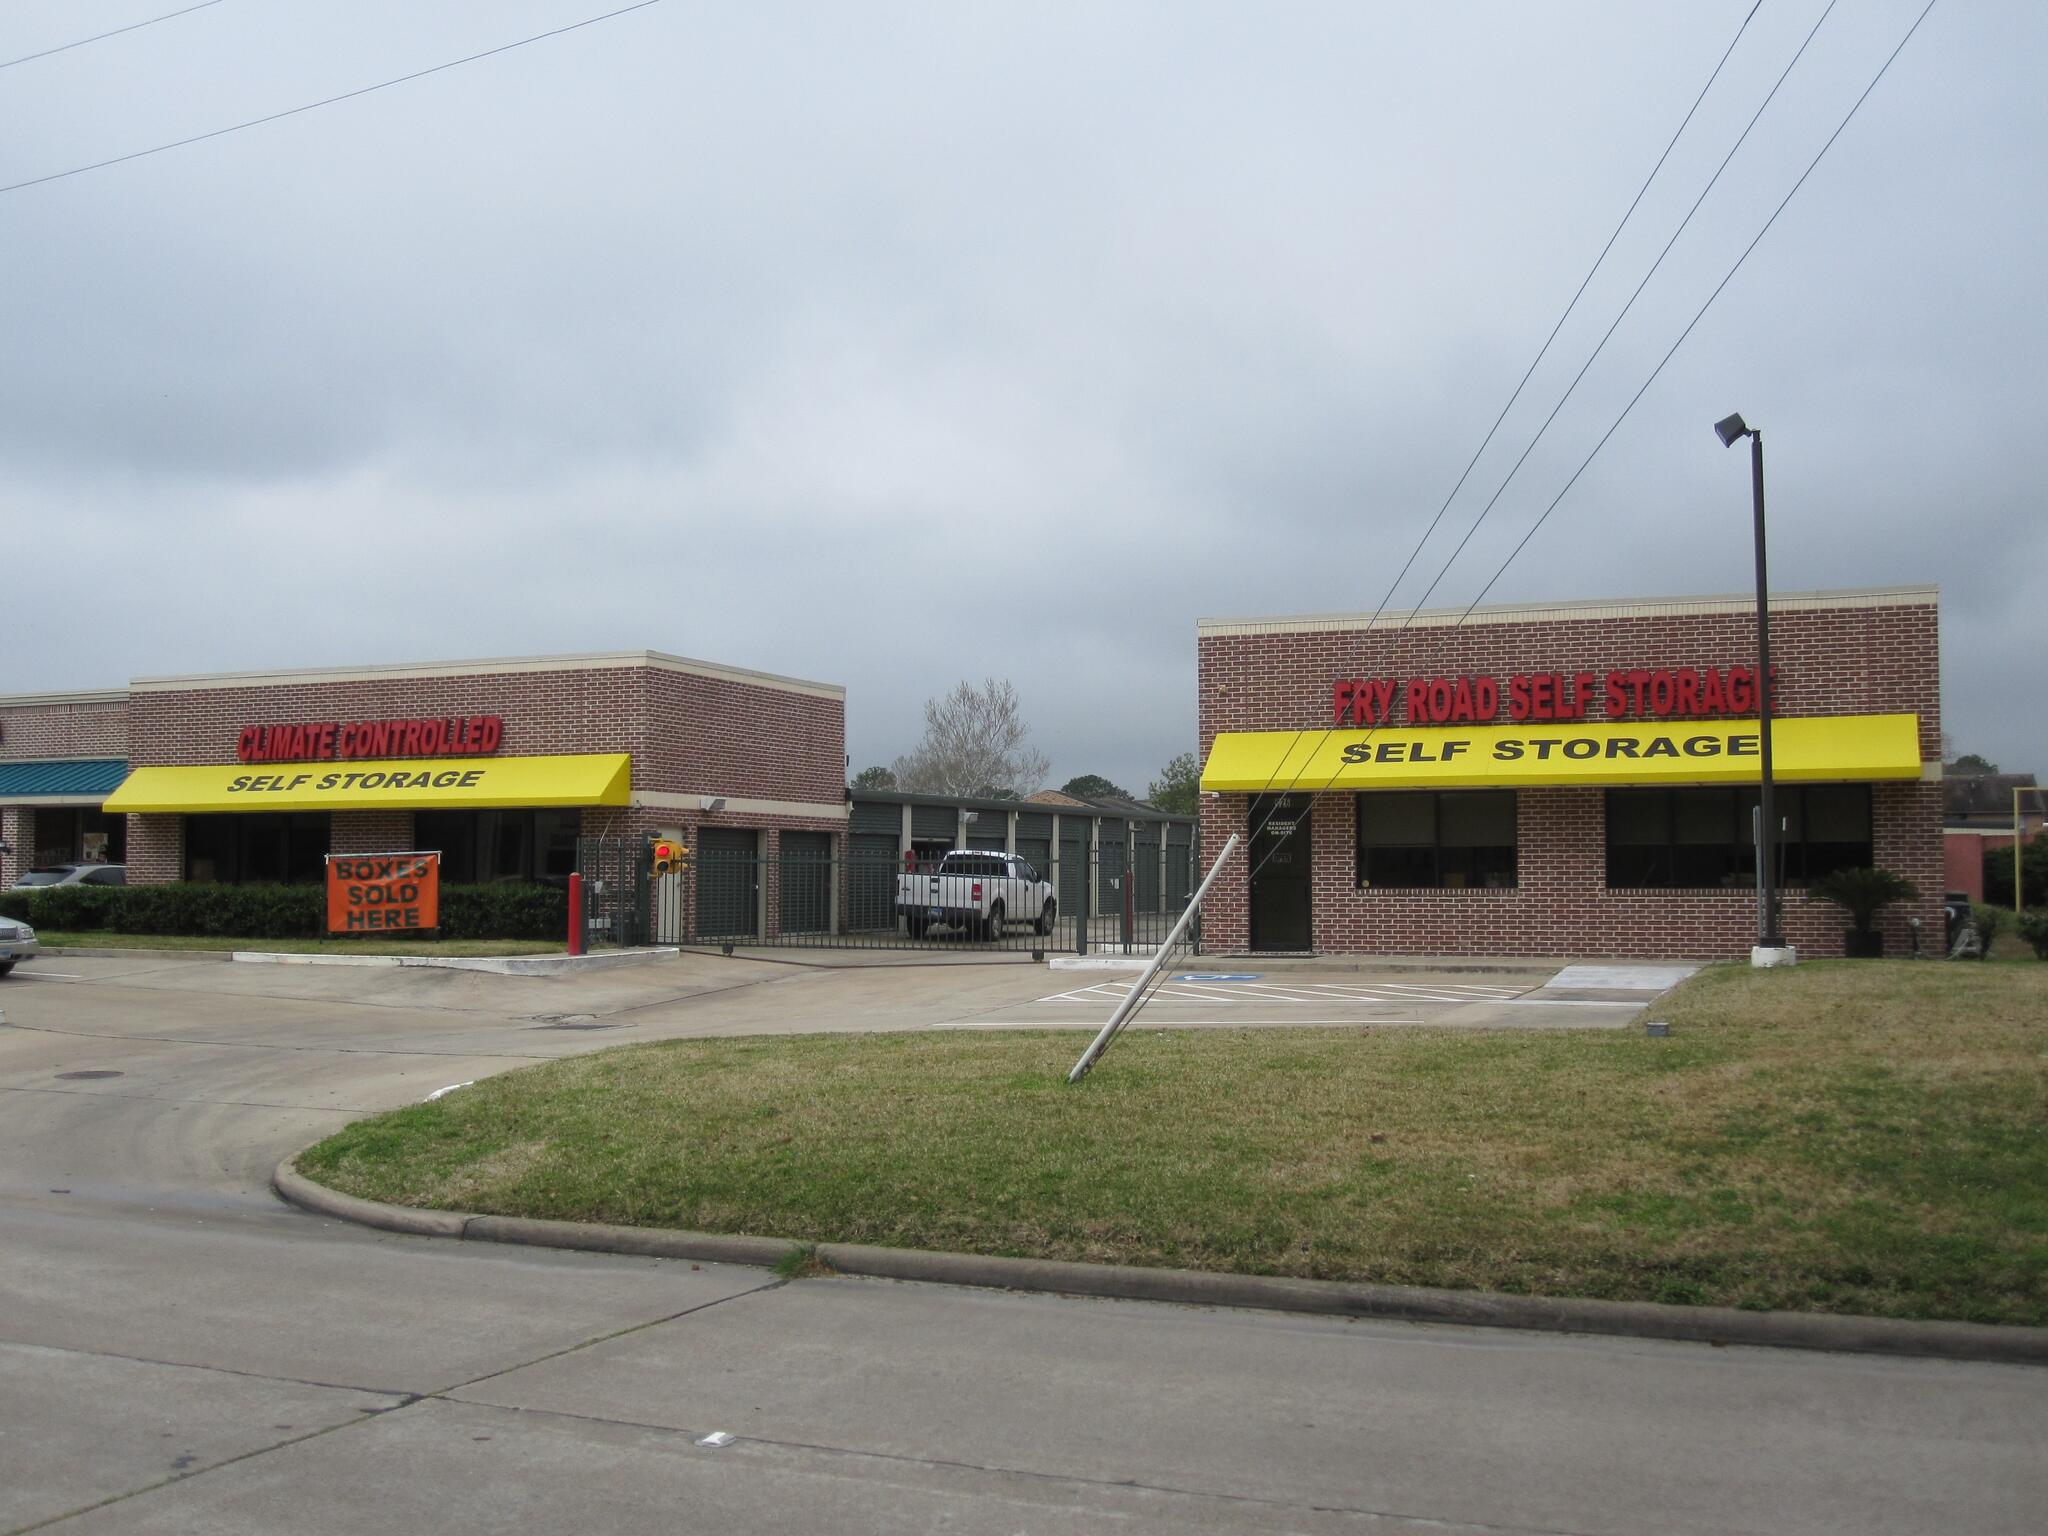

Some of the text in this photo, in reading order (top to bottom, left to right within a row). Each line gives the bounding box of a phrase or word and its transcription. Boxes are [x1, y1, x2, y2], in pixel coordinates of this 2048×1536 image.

[1334, 678, 1397, 725] FRY
[1407, 676, 1498, 722] ROAD
[1509, 671, 1594, 720] SELF
[238, 716, 502, 761] CLIMATE CONTROLLED
[1340, 735, 1760, 763] SELF STORAGE
[227, 770, 485, 791] SELF STORAGE
[336, 859, 428, 880] BOXES
[348, 884, 418, 905] SOLD
[346, 908, 420, 928] HERE
